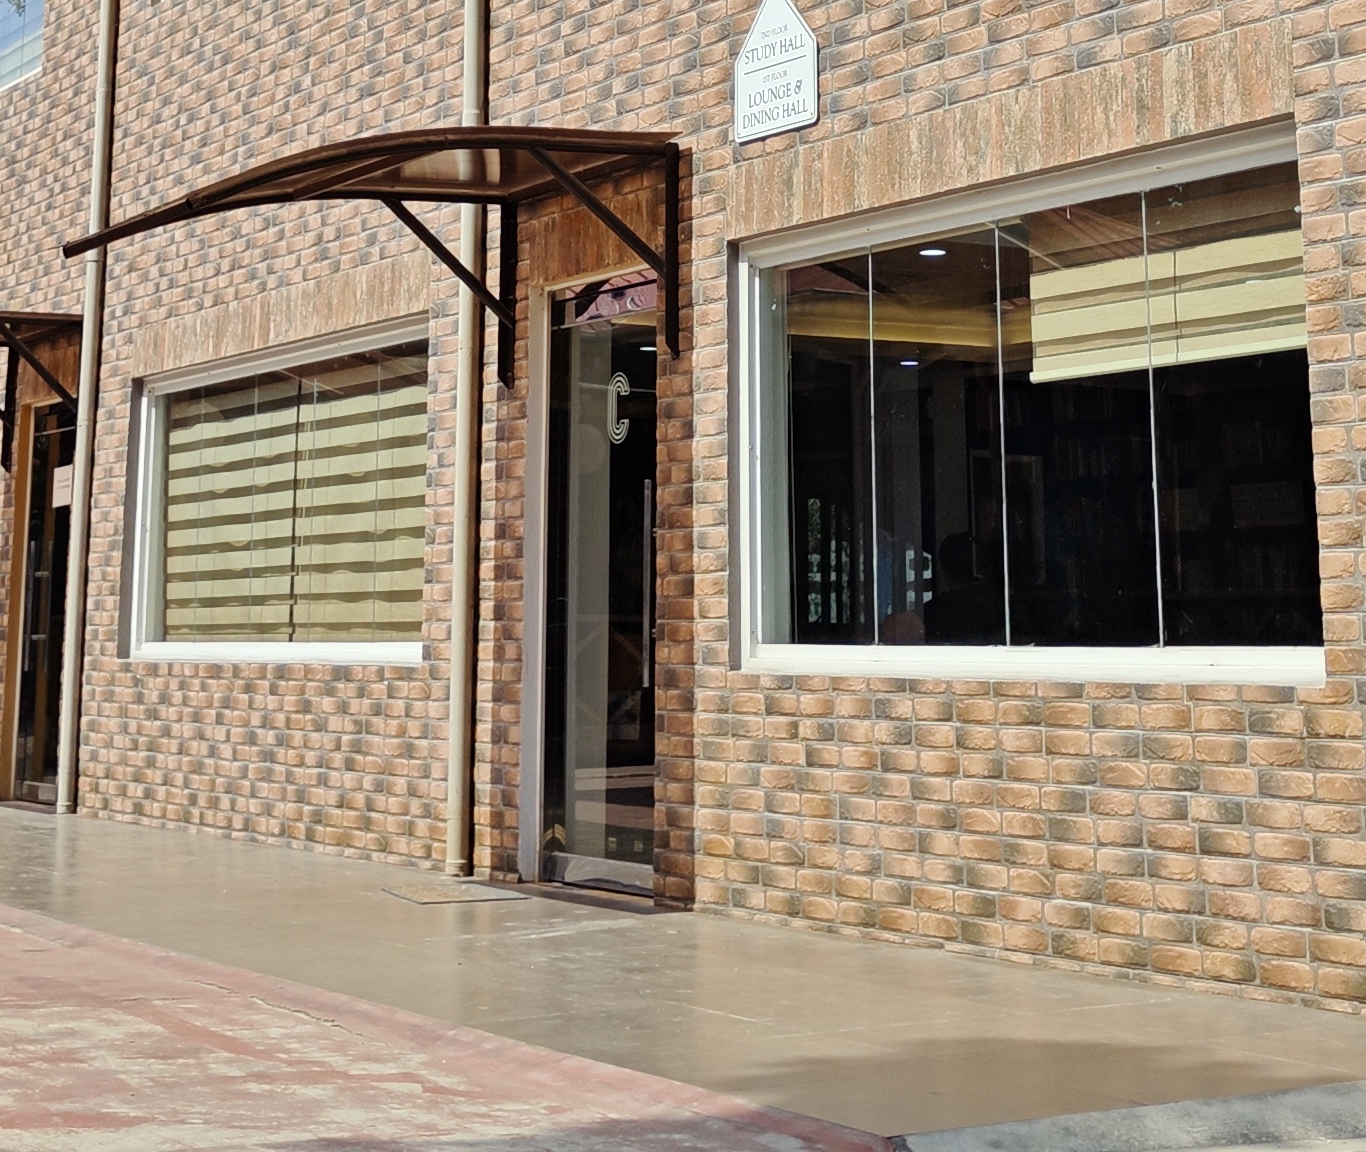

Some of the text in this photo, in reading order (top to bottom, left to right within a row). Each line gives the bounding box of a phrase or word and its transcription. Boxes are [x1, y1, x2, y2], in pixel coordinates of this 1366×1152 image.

[744, 33, 806, 65] STUDY HALL
[771, 69, 789, 81] FLOOR
[748, 79, 803, 108] LOUNGE &
[743, 98, 808, 129] DINING HALL
